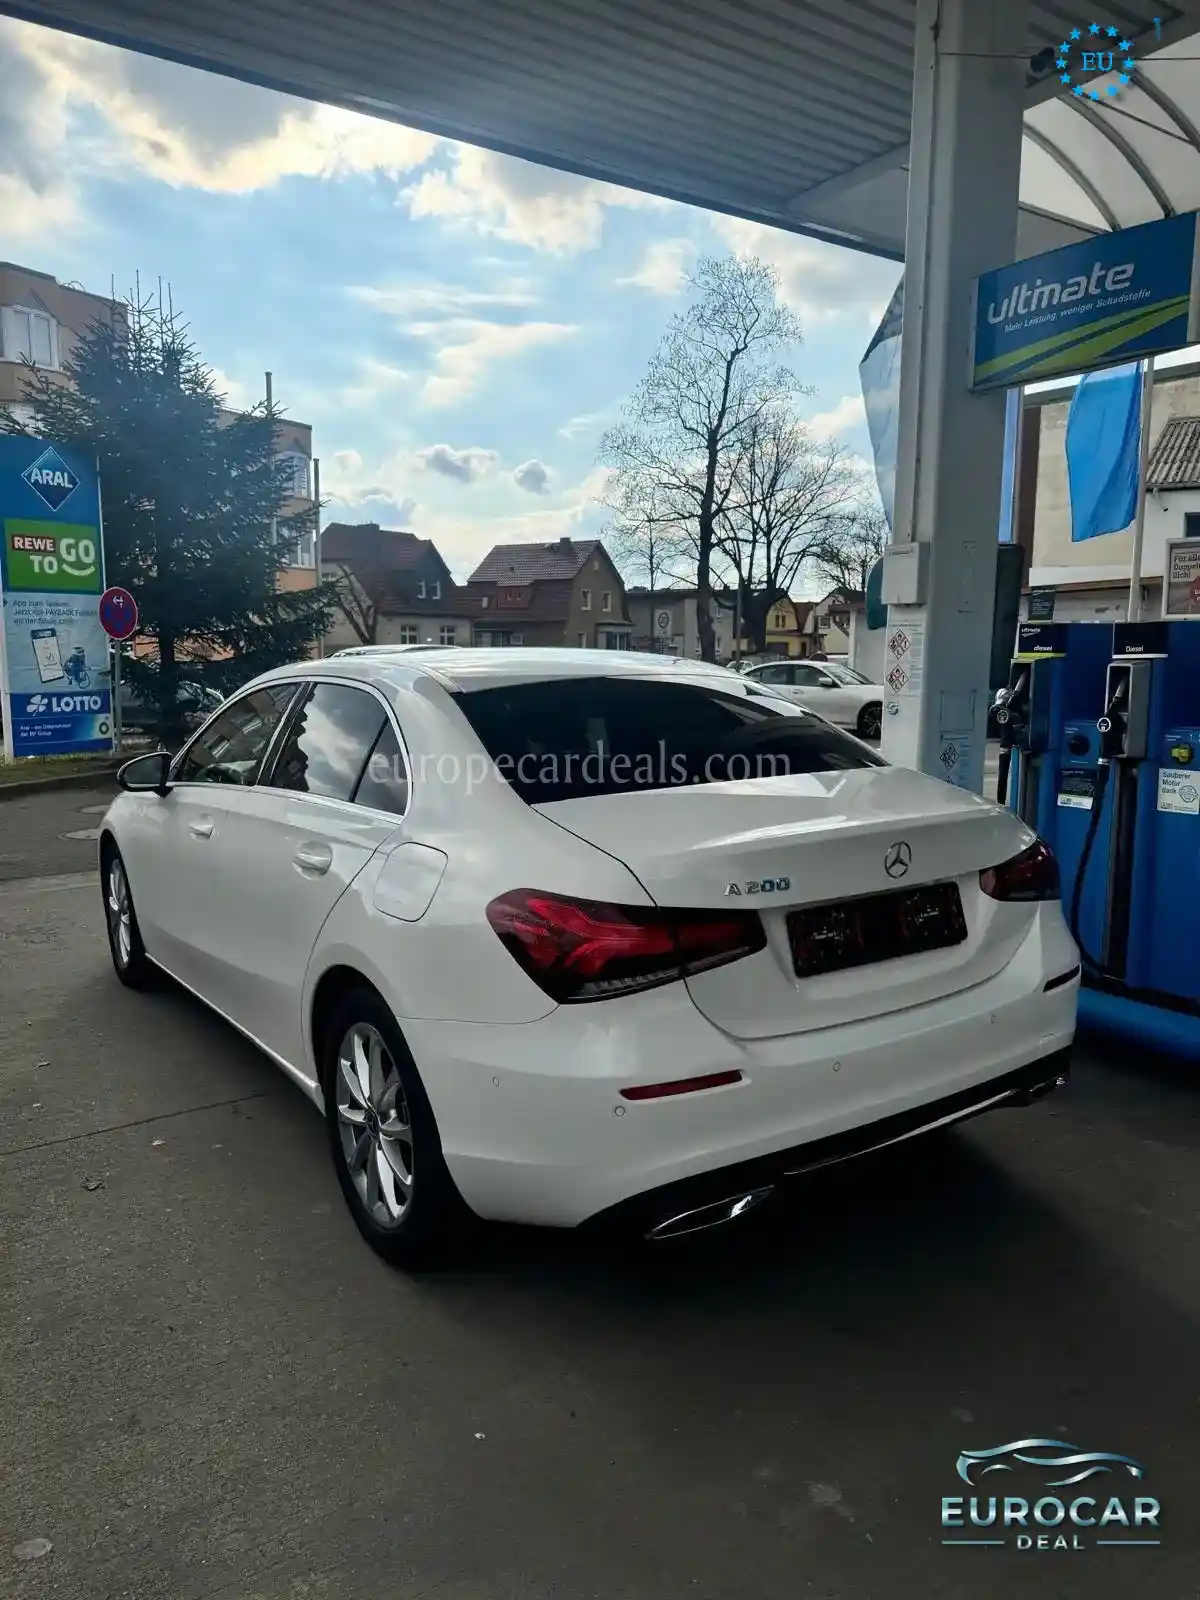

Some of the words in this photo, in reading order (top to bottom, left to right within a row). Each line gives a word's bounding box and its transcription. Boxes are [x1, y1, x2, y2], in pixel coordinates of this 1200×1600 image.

[987, 261, 1135, 325] ultimate
[30, 467, 73, 489] ARAL
[13, 536, 55, 552] REWE
[60, 538, 95, 564] GO
[30, 555, 58, 574] TO
[1125, 645, 1144, 653] Diesel
[52, 696, 102, 713] LOTTO
[1162, 772, 1191, 780] Sauberer
[724, 882, 742, 897] A
[744, 876, 791, 895] 200
